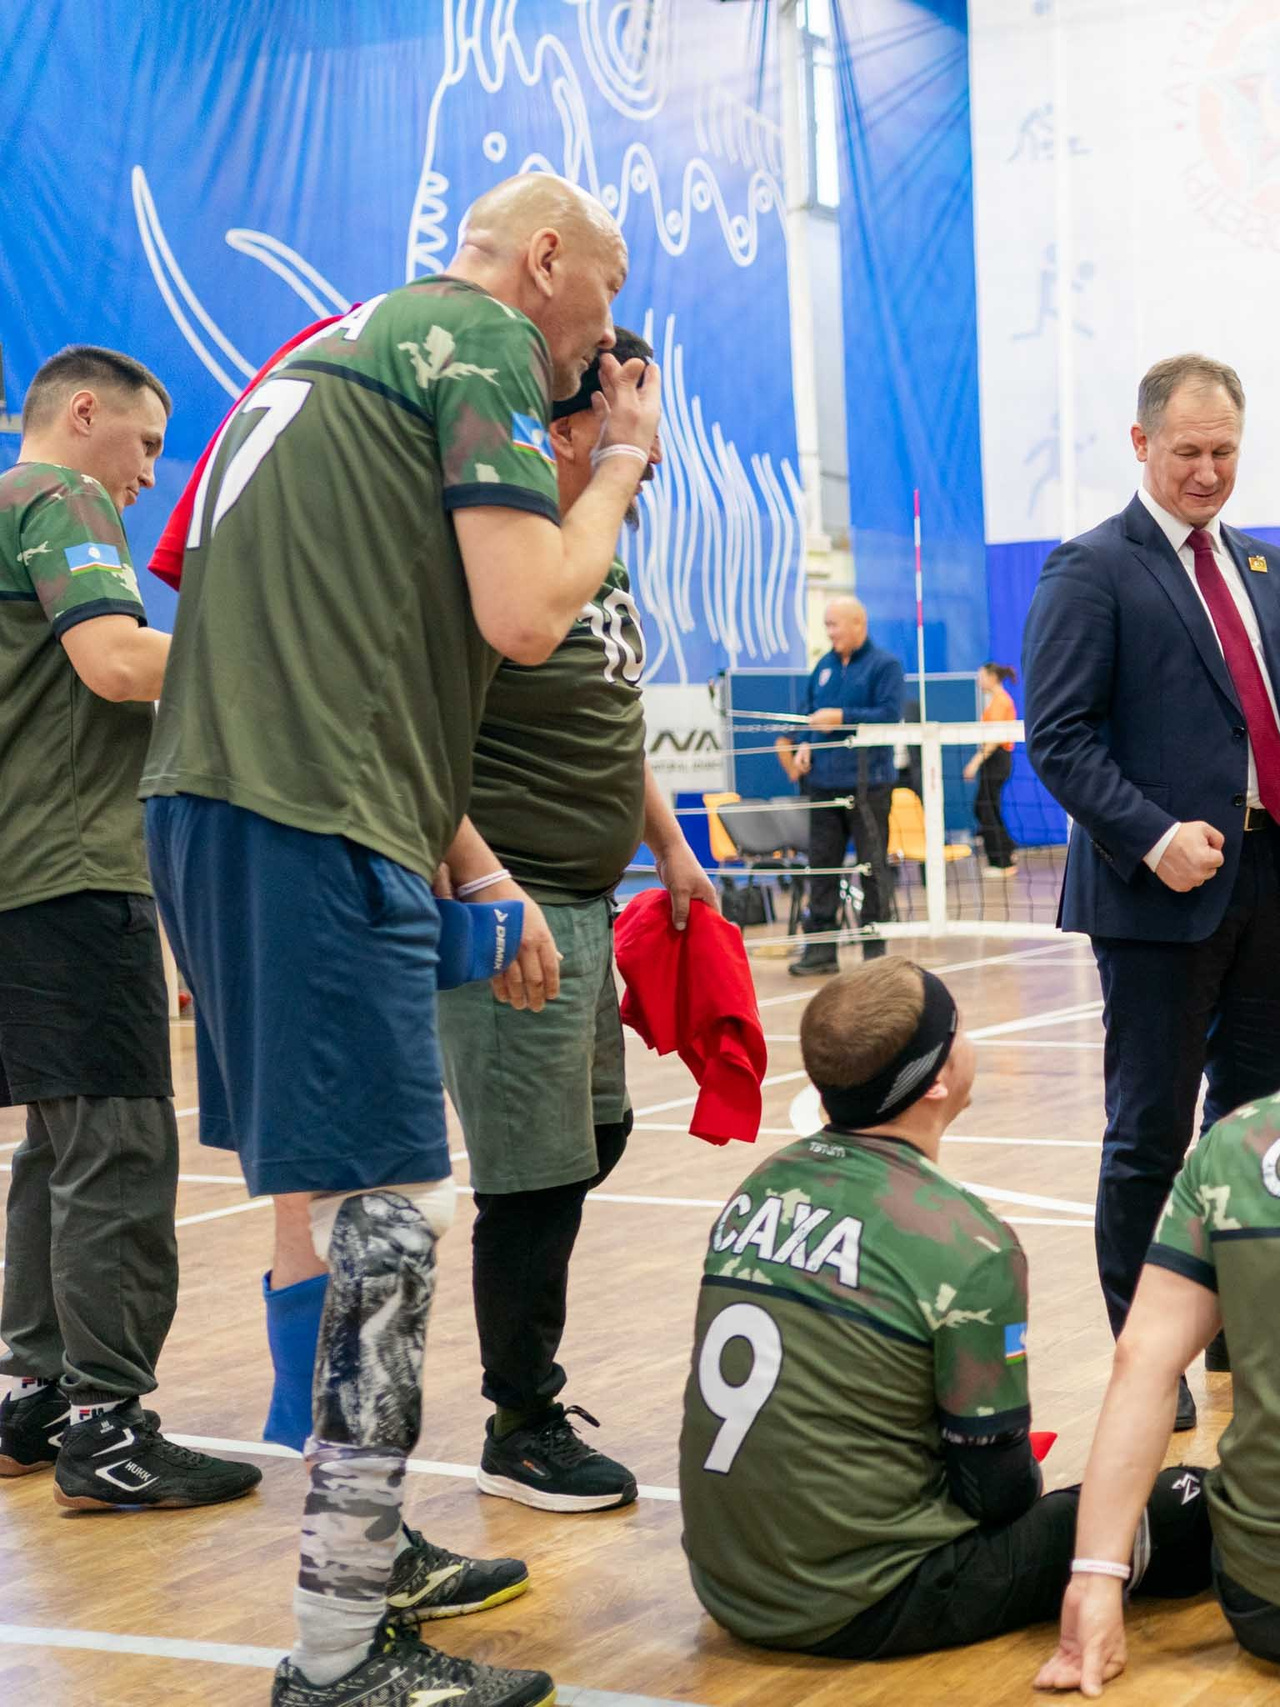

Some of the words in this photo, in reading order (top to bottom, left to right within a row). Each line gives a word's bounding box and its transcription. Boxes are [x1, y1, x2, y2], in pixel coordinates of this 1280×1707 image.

[576, 588, 646, 684] 10
[712, 1194, 864, 1289] САХА
[699, 1303, 783, 1474] 9
